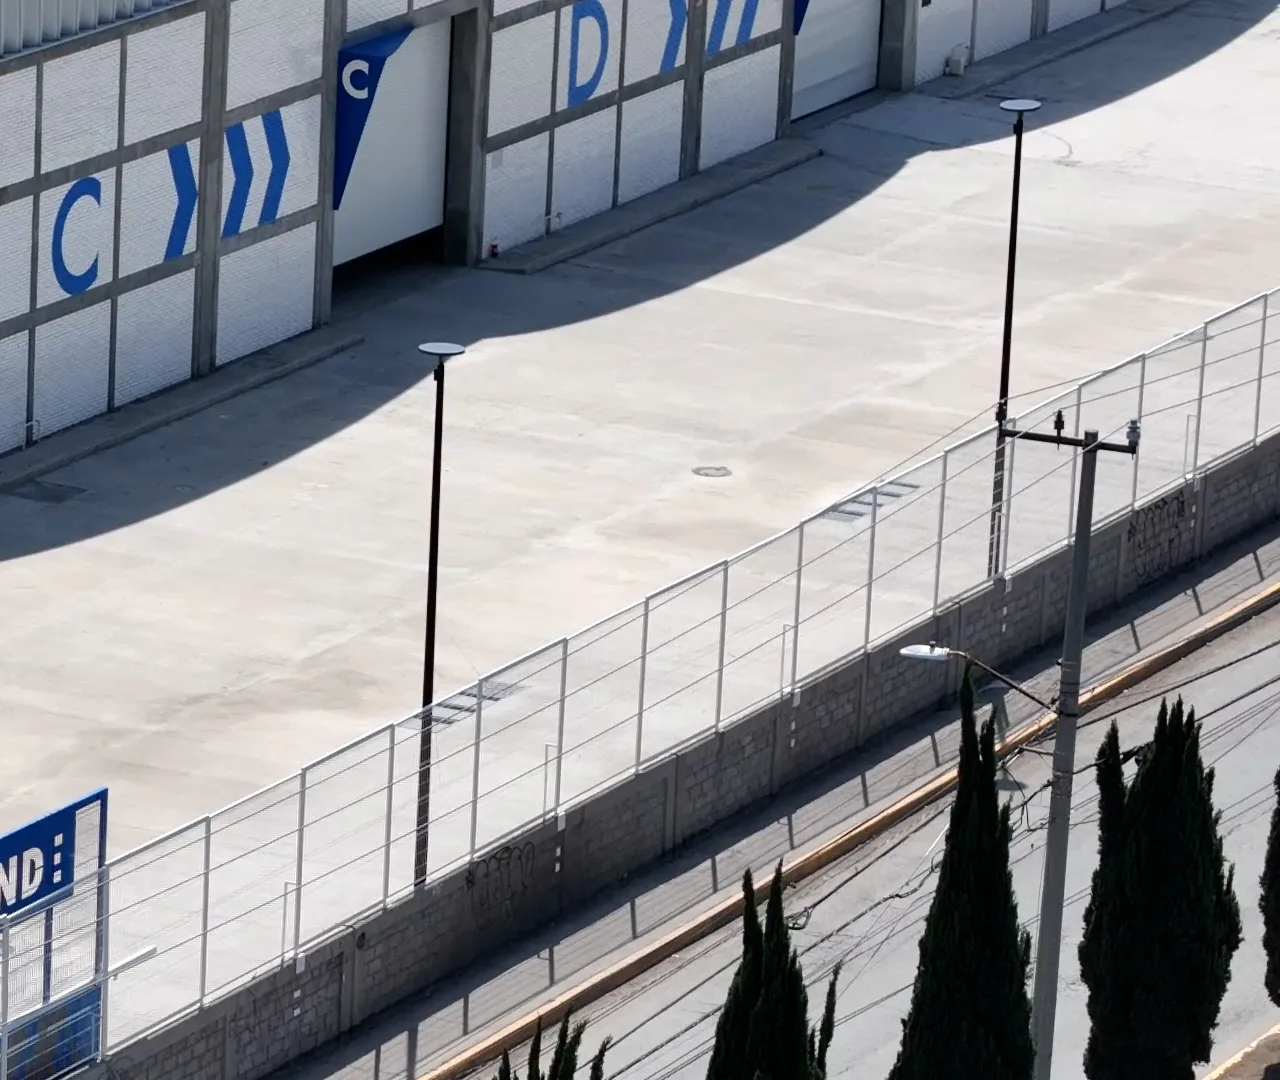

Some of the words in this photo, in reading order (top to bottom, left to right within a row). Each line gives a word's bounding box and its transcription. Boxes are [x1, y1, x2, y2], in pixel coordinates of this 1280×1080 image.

[341, 58, 370, 99] C
[568, 0, 609, 107] D
[51, 176, 102, 296] C
